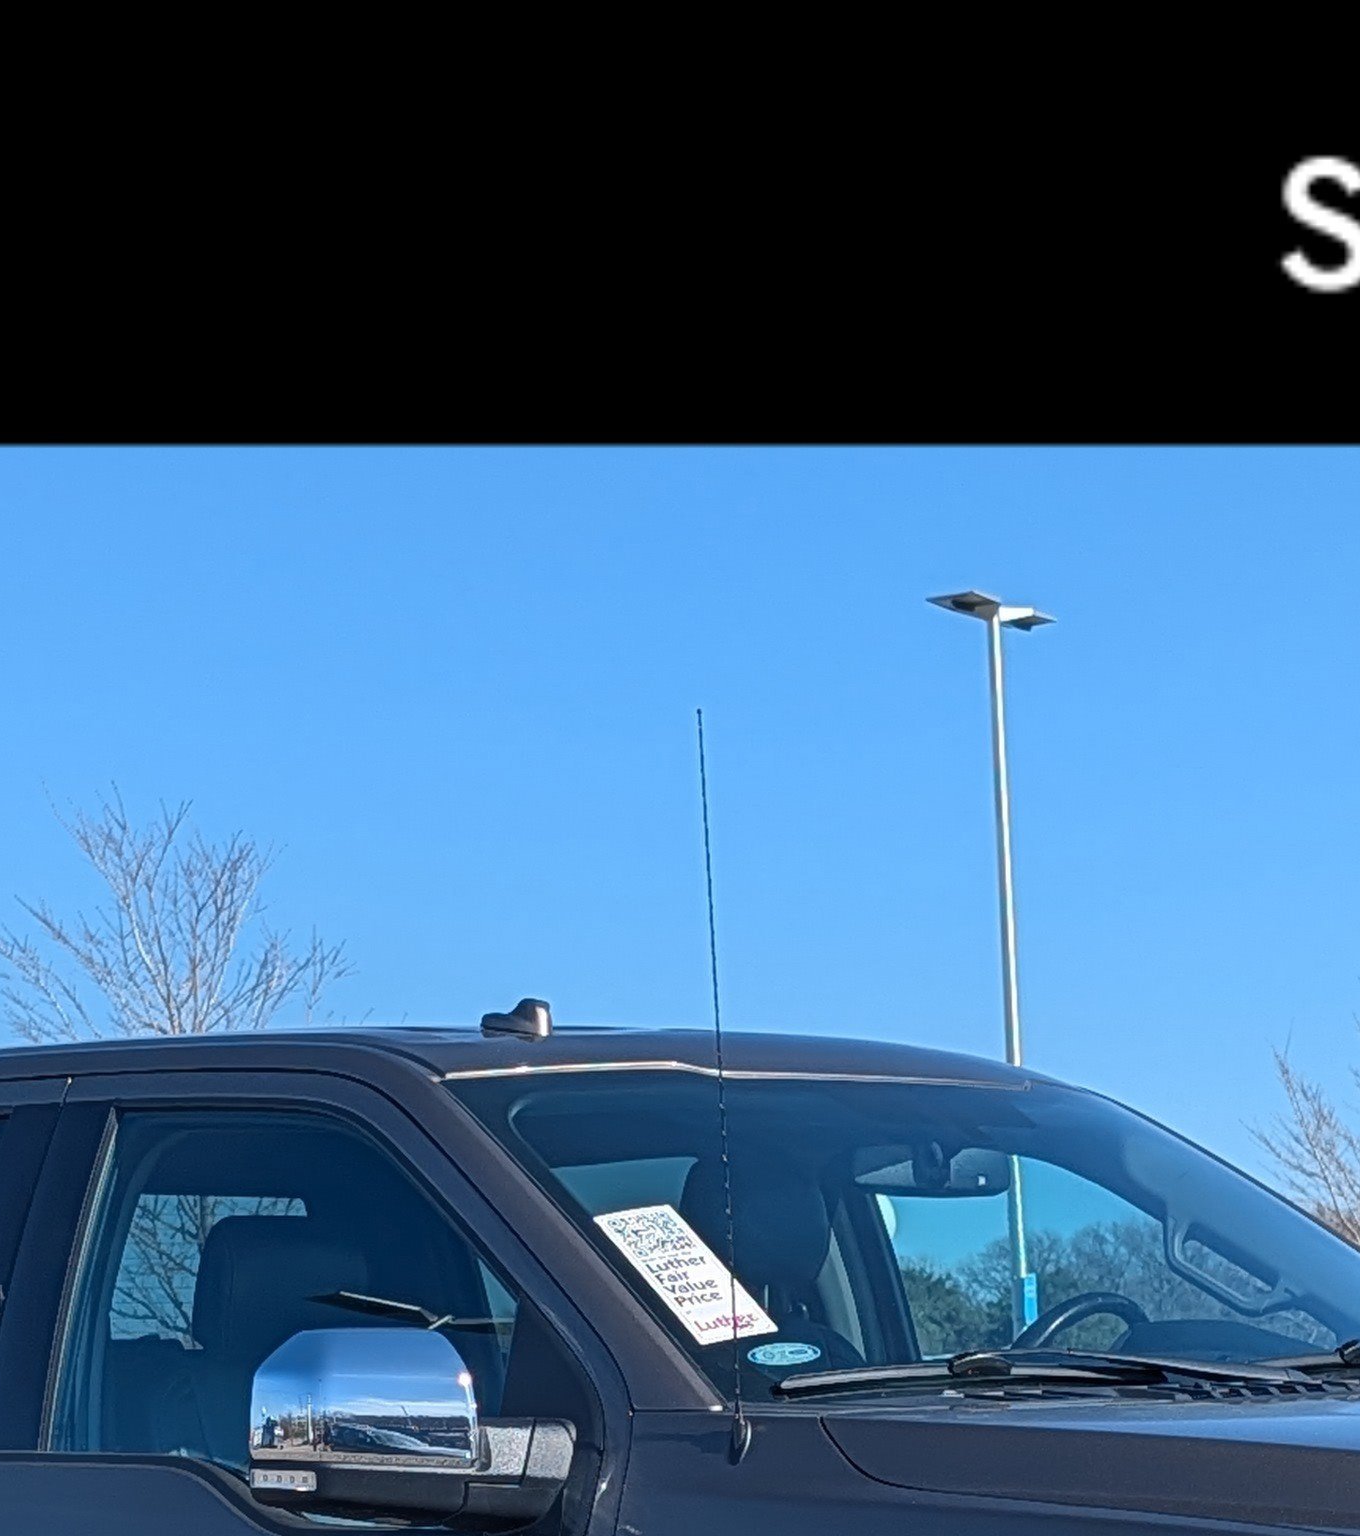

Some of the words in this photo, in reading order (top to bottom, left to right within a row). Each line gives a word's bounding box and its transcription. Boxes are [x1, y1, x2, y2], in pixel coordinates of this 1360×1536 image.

[646, 1256, 707, 1274] Luther
[655, 1271, 689, 1285] Fair
[663, 1280, 718, 1294] Value
[674, 1292, 723, 1307] Price
